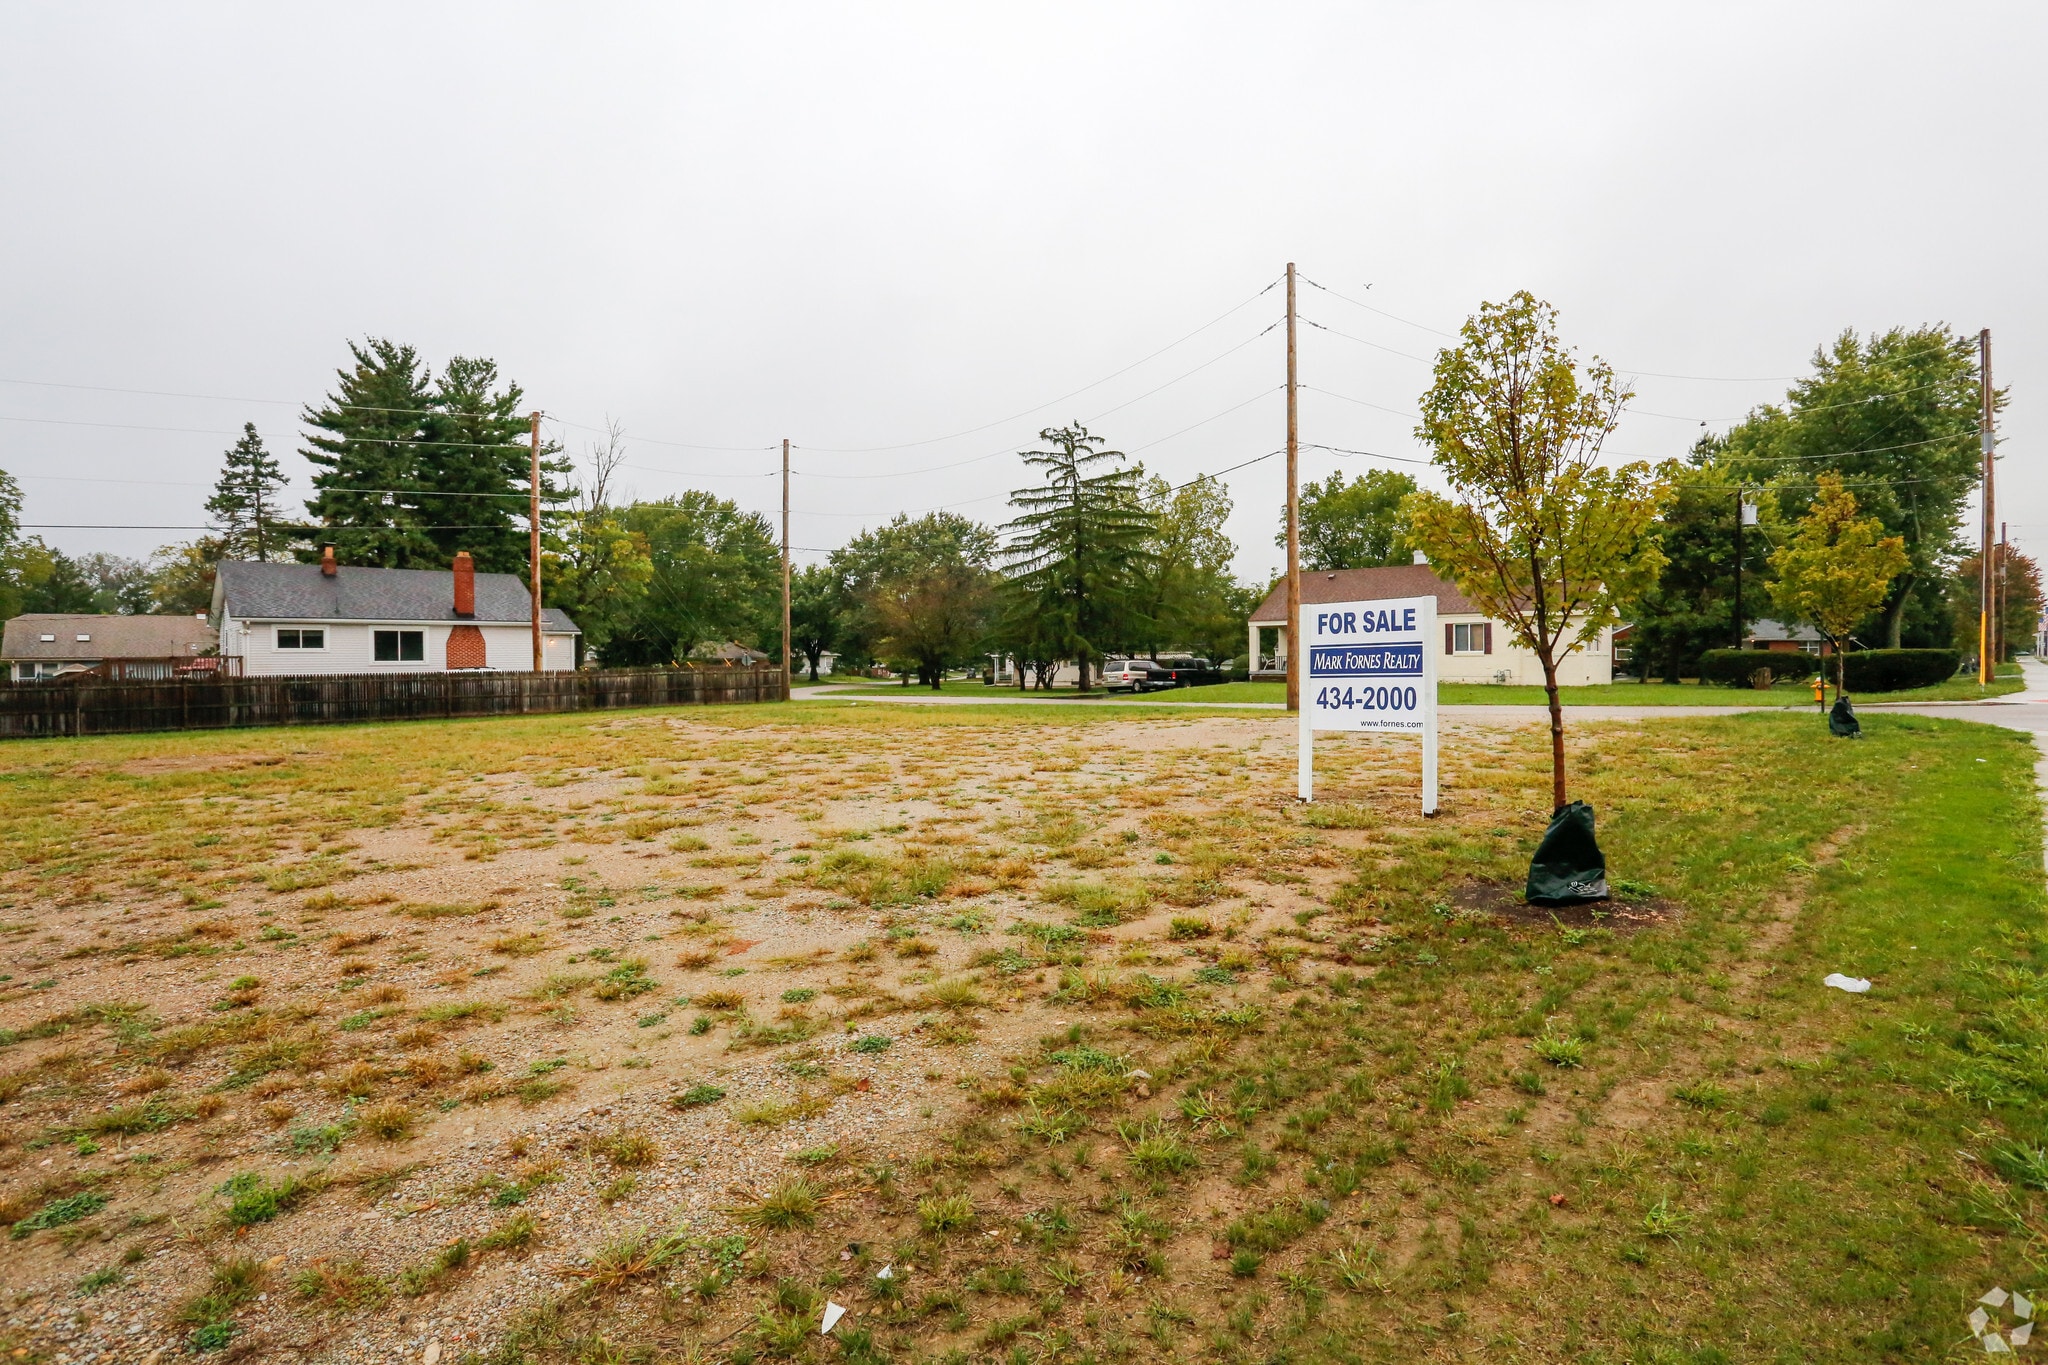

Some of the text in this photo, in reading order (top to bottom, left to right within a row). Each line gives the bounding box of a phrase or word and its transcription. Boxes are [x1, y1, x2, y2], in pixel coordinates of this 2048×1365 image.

[1318, 608, 1416, 635] FOR SALE
[1314, 651, 1421, 670] MARK FORNES REALTY
[1316, 686, 1417, 710] 434-2000
[1360, 719, 1424, 728] www.fornes.com
